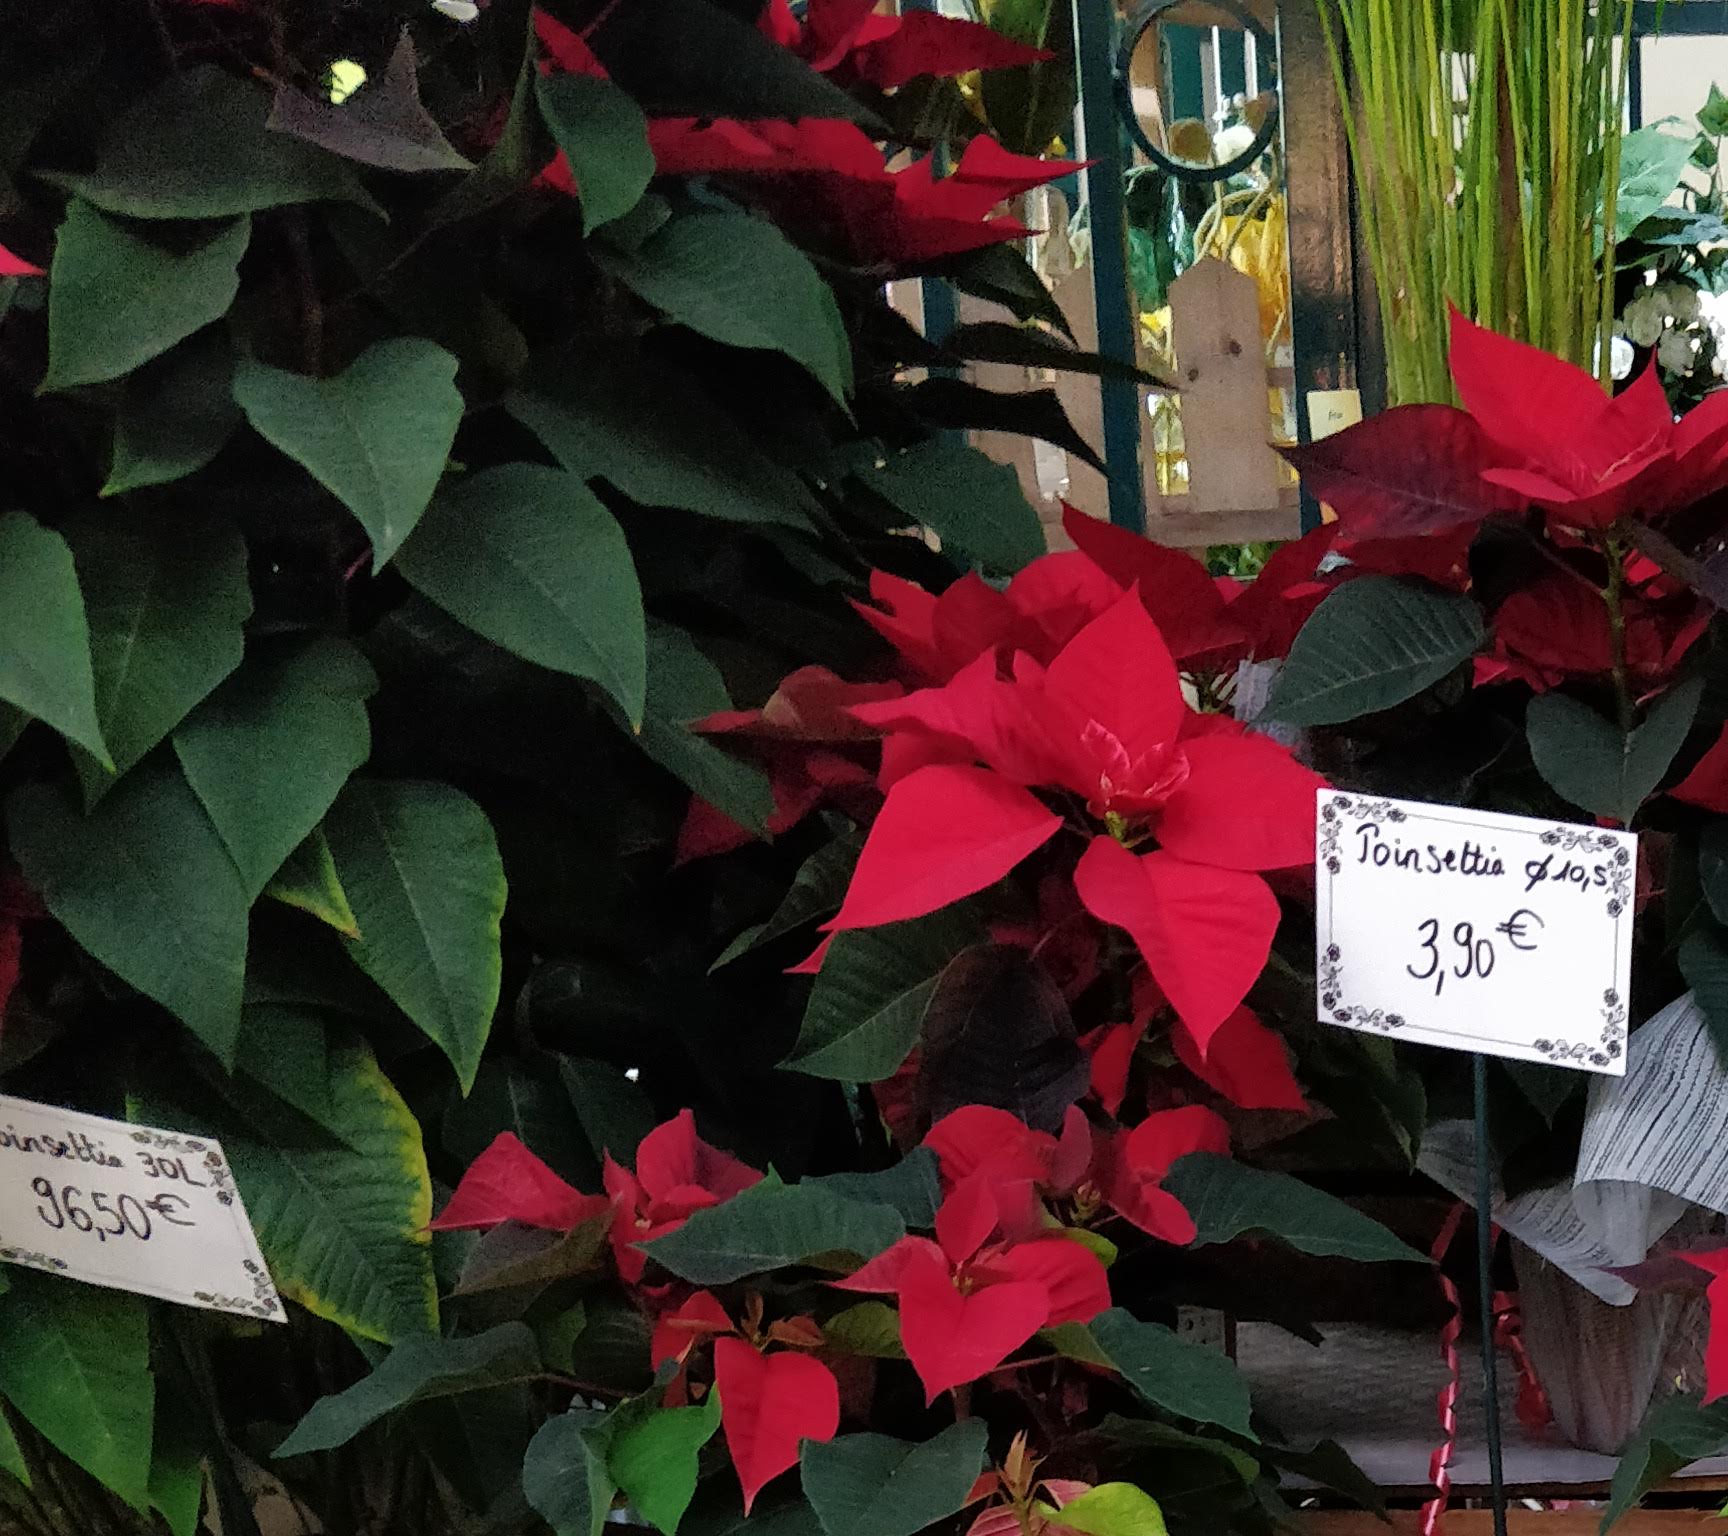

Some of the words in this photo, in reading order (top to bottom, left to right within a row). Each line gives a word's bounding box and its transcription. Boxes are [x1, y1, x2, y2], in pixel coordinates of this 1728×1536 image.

[1356, 822, 1505, 877] Poinsettia
[1406, 909, 1545, 996] 3,90€
[0, 1124, 123, 1168] oinsettia
[31, 1176, 196, 1242] 96,50€
